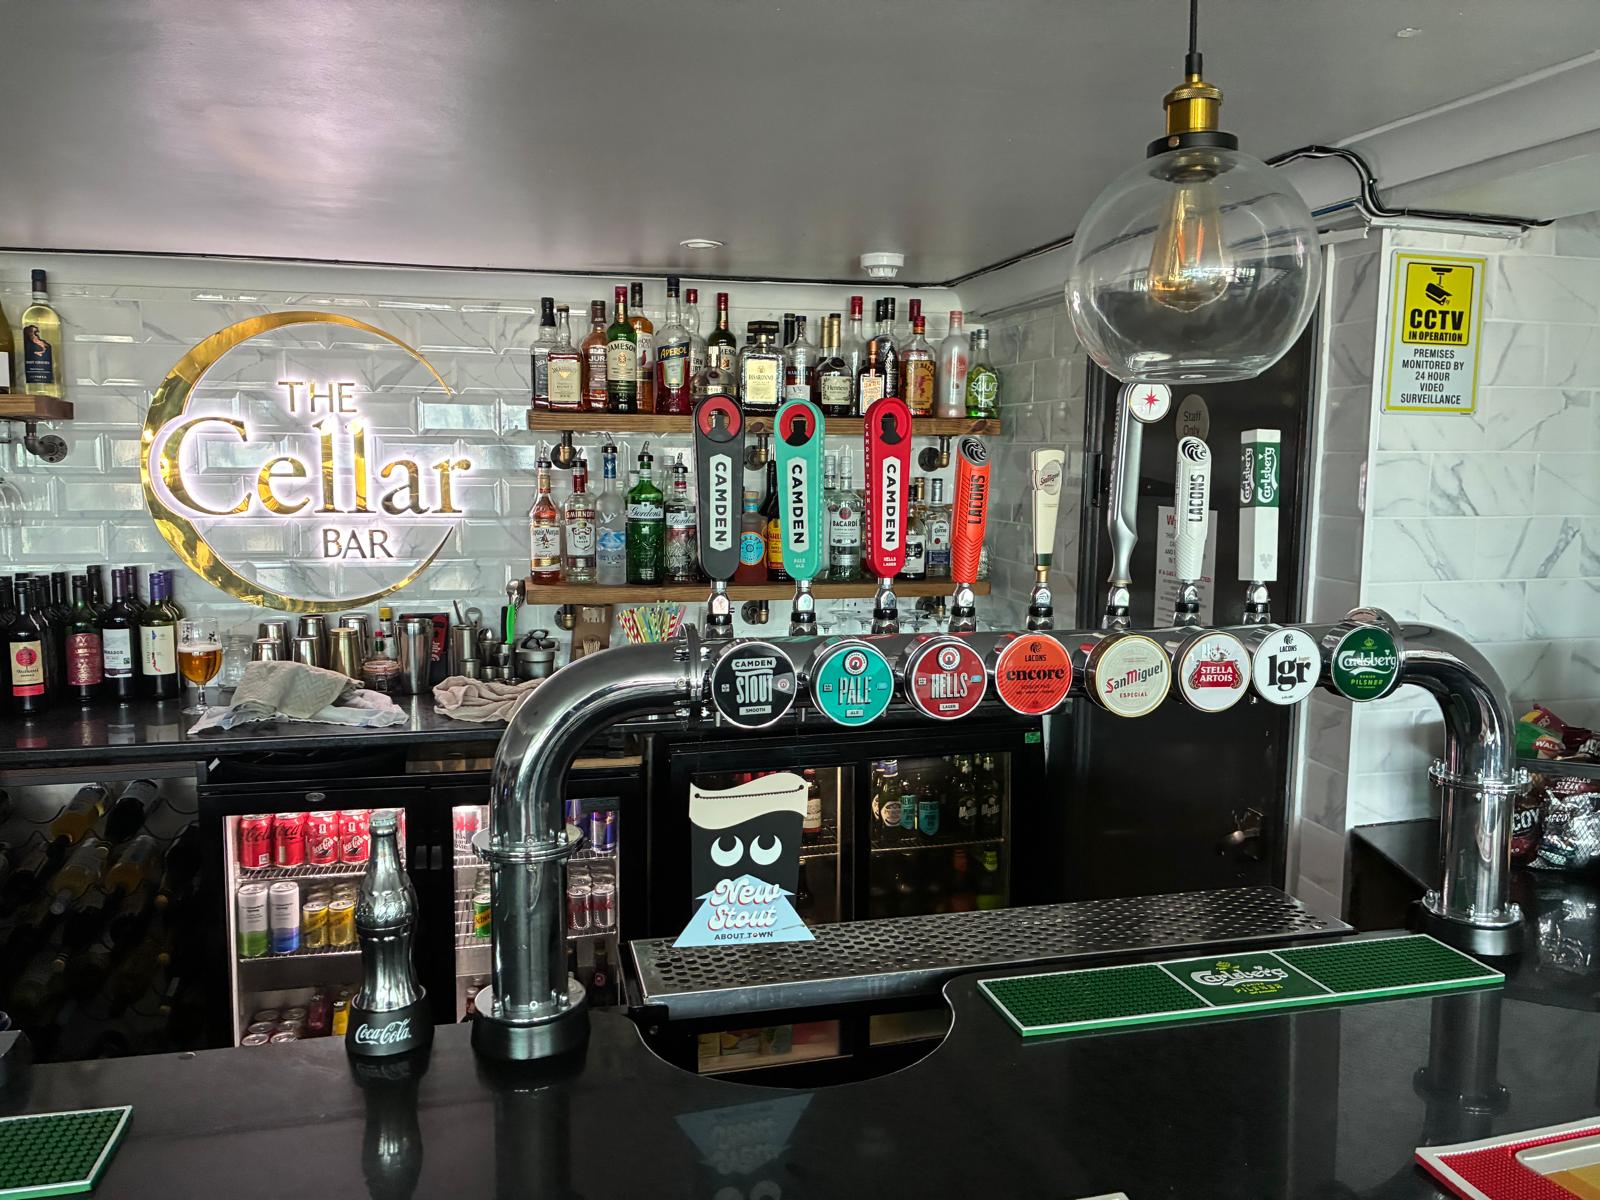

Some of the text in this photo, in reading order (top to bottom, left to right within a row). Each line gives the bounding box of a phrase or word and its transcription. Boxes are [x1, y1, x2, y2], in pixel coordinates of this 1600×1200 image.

[1410, 308, 1464, 331] CCTV
[1408, 331, 1463, 342] IN OPERATION
[660, 346, 688, 358] APEROL
[1413, 348, 1455, 359] PREMISES
[1402, 360, 1465, 371] MONITORED BY
[1415, 371, 1450, 382] 24 HOUR
[277, 380, 358, 414] THE
[1419, 382, 1445, 392] VIDEO
[1400, 393, 1461, 405] SURVEILLANCE
[1183, 410, 1202, 422] Staff
[160, 416, 473, 517] Cellar
[1241, 447, 1255, 504] Carlsberg
[1257, 447, 1279, 503] Carlsberg
[714, 461, 727, 543] CAMDEN
[791, 464, 805, 545] CAMDEN
[885, 463, 896, 543] CAMDEN
[967, 474, 985, 525] LACONS
[1188, 473, 1205, 523] LACONS
[321, 528, 395, 560] BAR
[1024, 654, 1047, 662] LACONS
[1279, 644, 1298, 653] LACONS
[734, 659, 774, 669] CAMDEN
[1200, 665, 1233, 674] STELLA
[1337, 649, 1397, 673] Carlsberg
[1006, 667, 1065, 682] encore
[1199, 673, 1233, 682] ARTOIS
[1267, 654, 1312, 692] lgr
[1350, 678, 1384, 686] PILSNER
[735, 669, 774, 704] STOUT
[837, 676, 872, 705] PALE
[930, 672, 969, 699] HELLS
[1119, 691, 1149, 699] ESPECIAL
[1555, 781, 1580, 791] STEAK
[709, 878, 782, 907] New
[707, 904, 778, 931] Stout
[714, 931, 774, 941] ABOUT TOWN
[1190, 965, 1289, 987] Carlsberg
[354, 1018, 413, 1046] Coca-Cola
